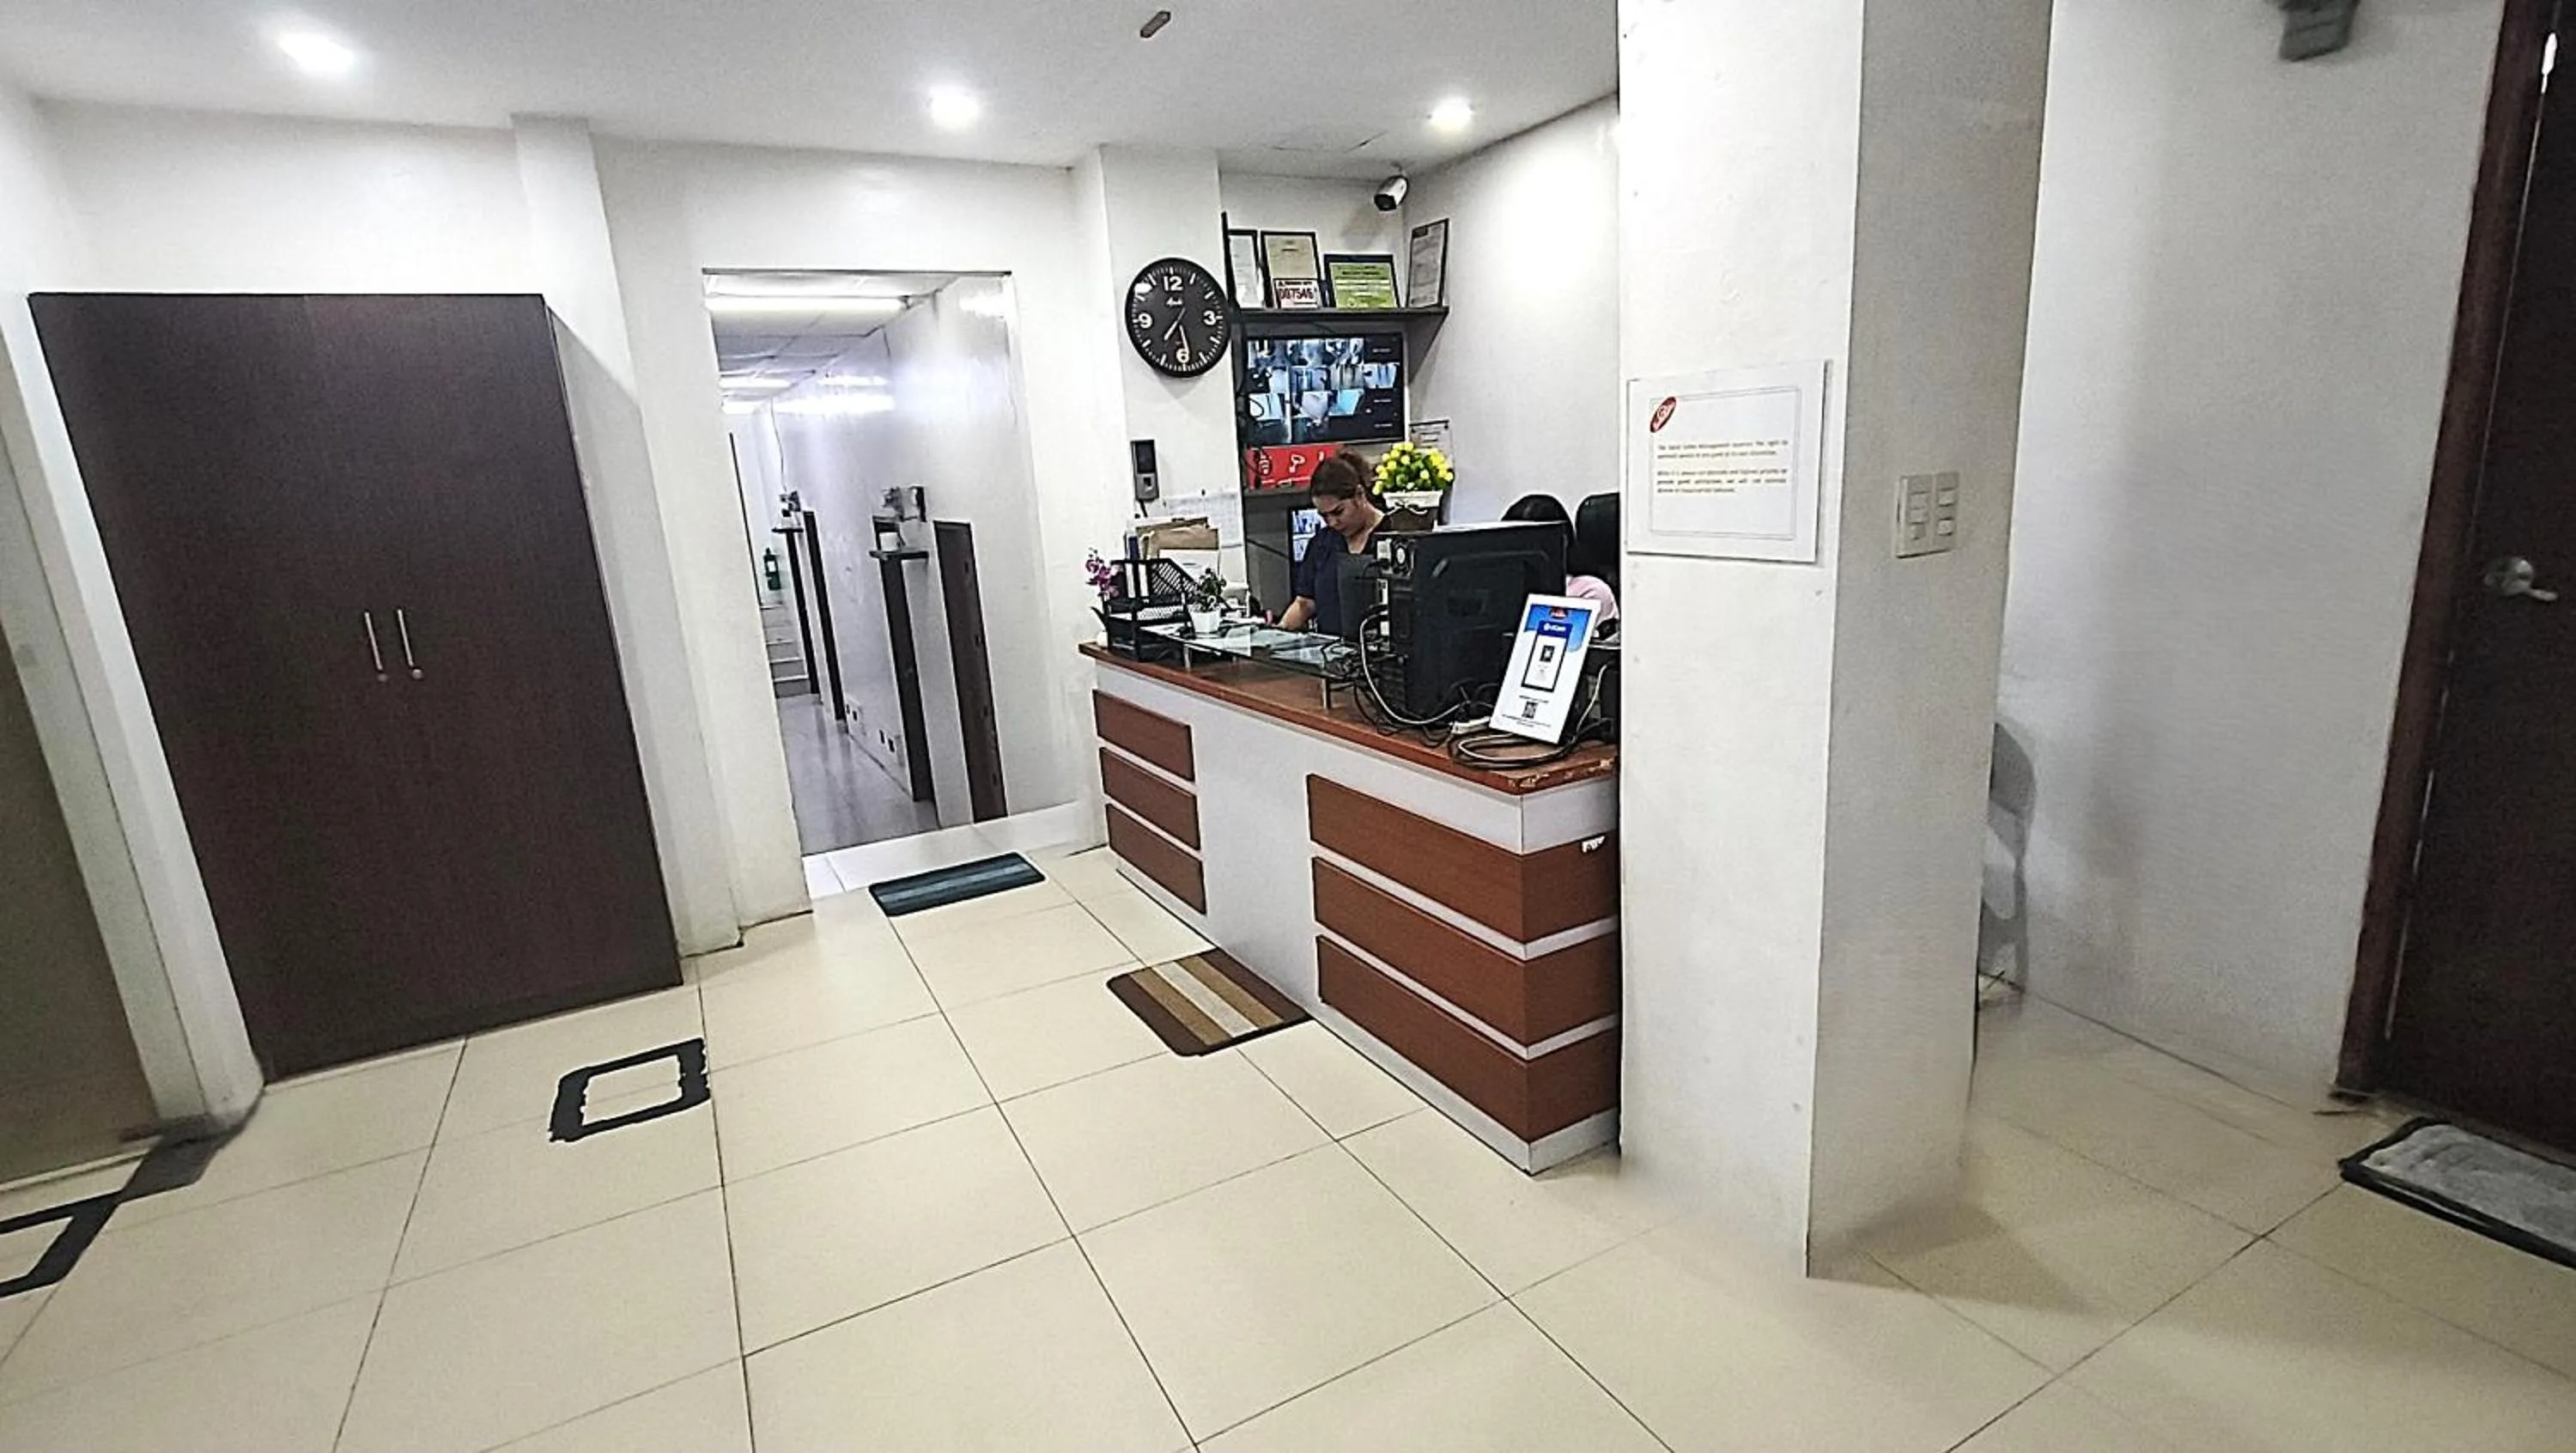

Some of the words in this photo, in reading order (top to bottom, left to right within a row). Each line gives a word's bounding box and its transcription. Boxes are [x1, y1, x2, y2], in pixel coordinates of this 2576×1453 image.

[1163, 275, 1183, 291] 12
[1138, 313, 1152, 329] 9
[1203, 310, 1217, 325] 3
[1176, 348, 1190, 363] 6
